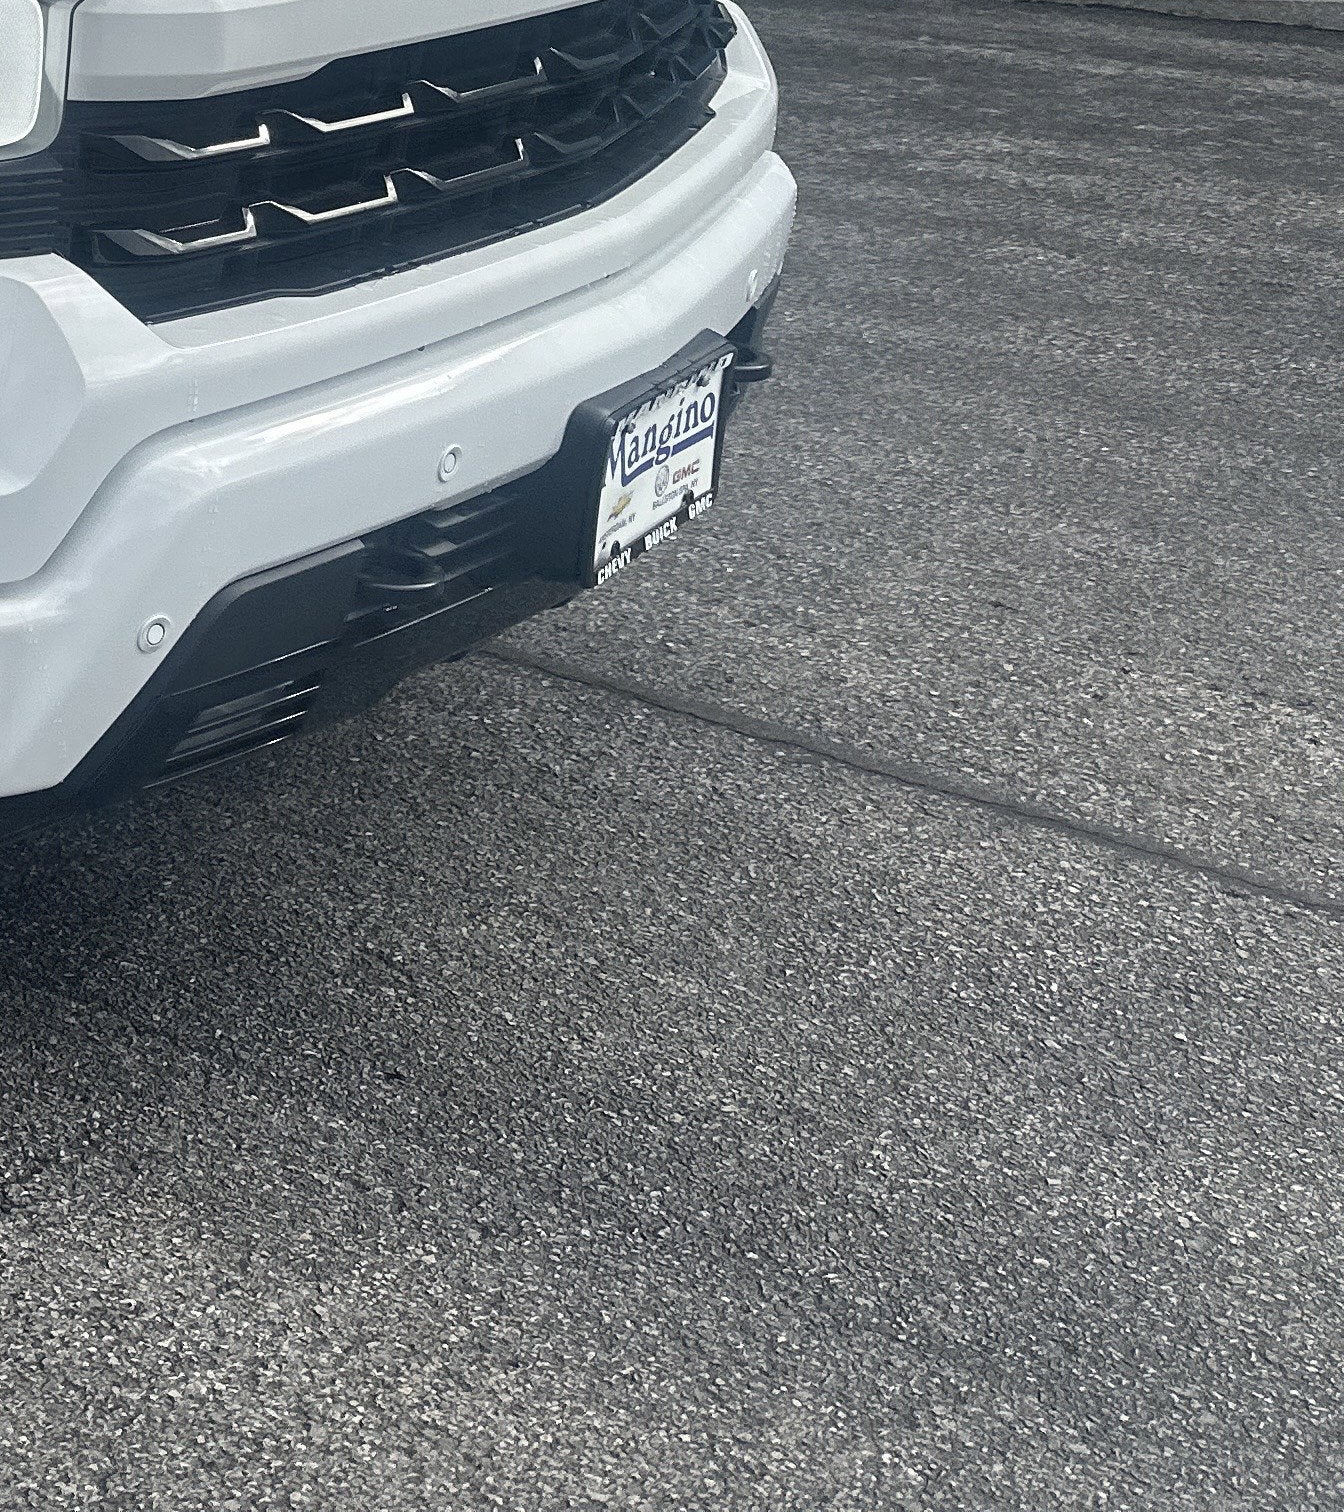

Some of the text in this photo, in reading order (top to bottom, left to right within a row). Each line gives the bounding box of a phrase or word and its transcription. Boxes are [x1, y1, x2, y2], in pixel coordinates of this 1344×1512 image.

[609, 392, 715, 487] Mangino
[672, 459, 700, 485] GMC
[597, 548, 632, 585] CHEVY
[644, 516, 678, 551] BUICK
[687, 493, 713, 520] GMC
